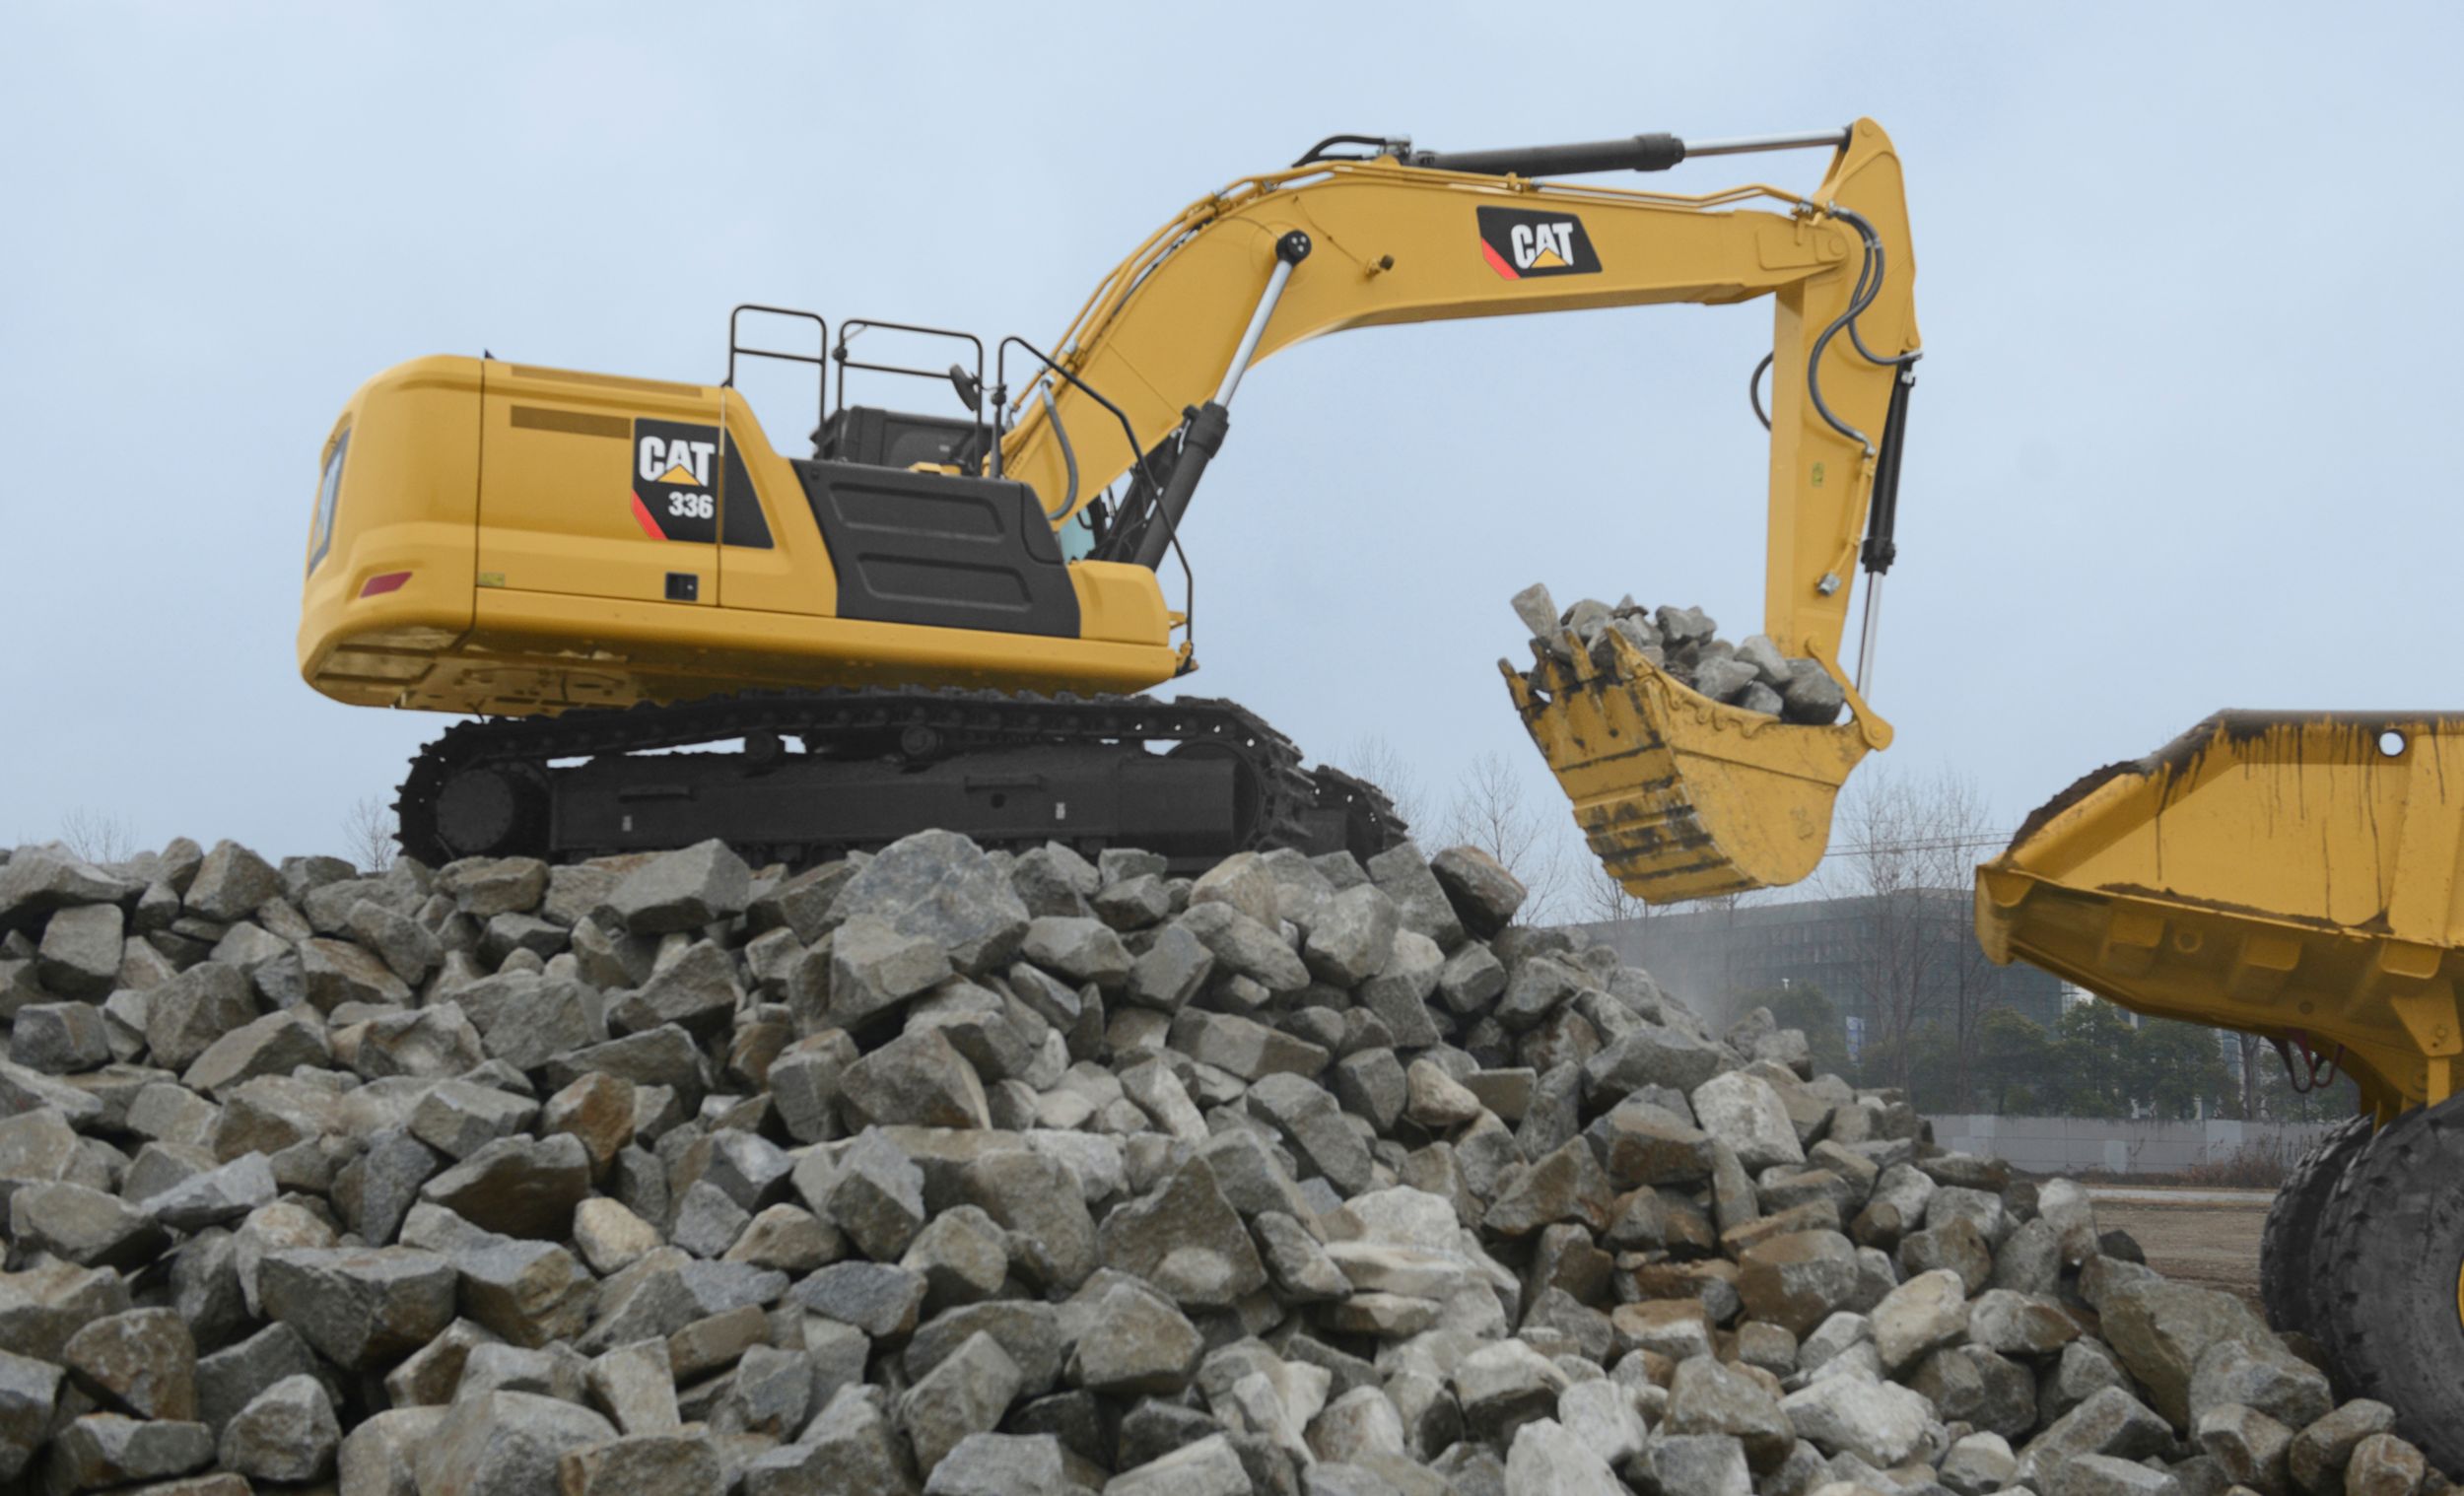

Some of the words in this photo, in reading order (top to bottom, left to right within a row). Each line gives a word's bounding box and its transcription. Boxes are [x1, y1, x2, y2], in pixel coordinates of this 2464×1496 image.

[1511, 222, 1574, 269] CAT
[639, 436, 716, 487] CAT
[668, 491, 715, 519] 336
